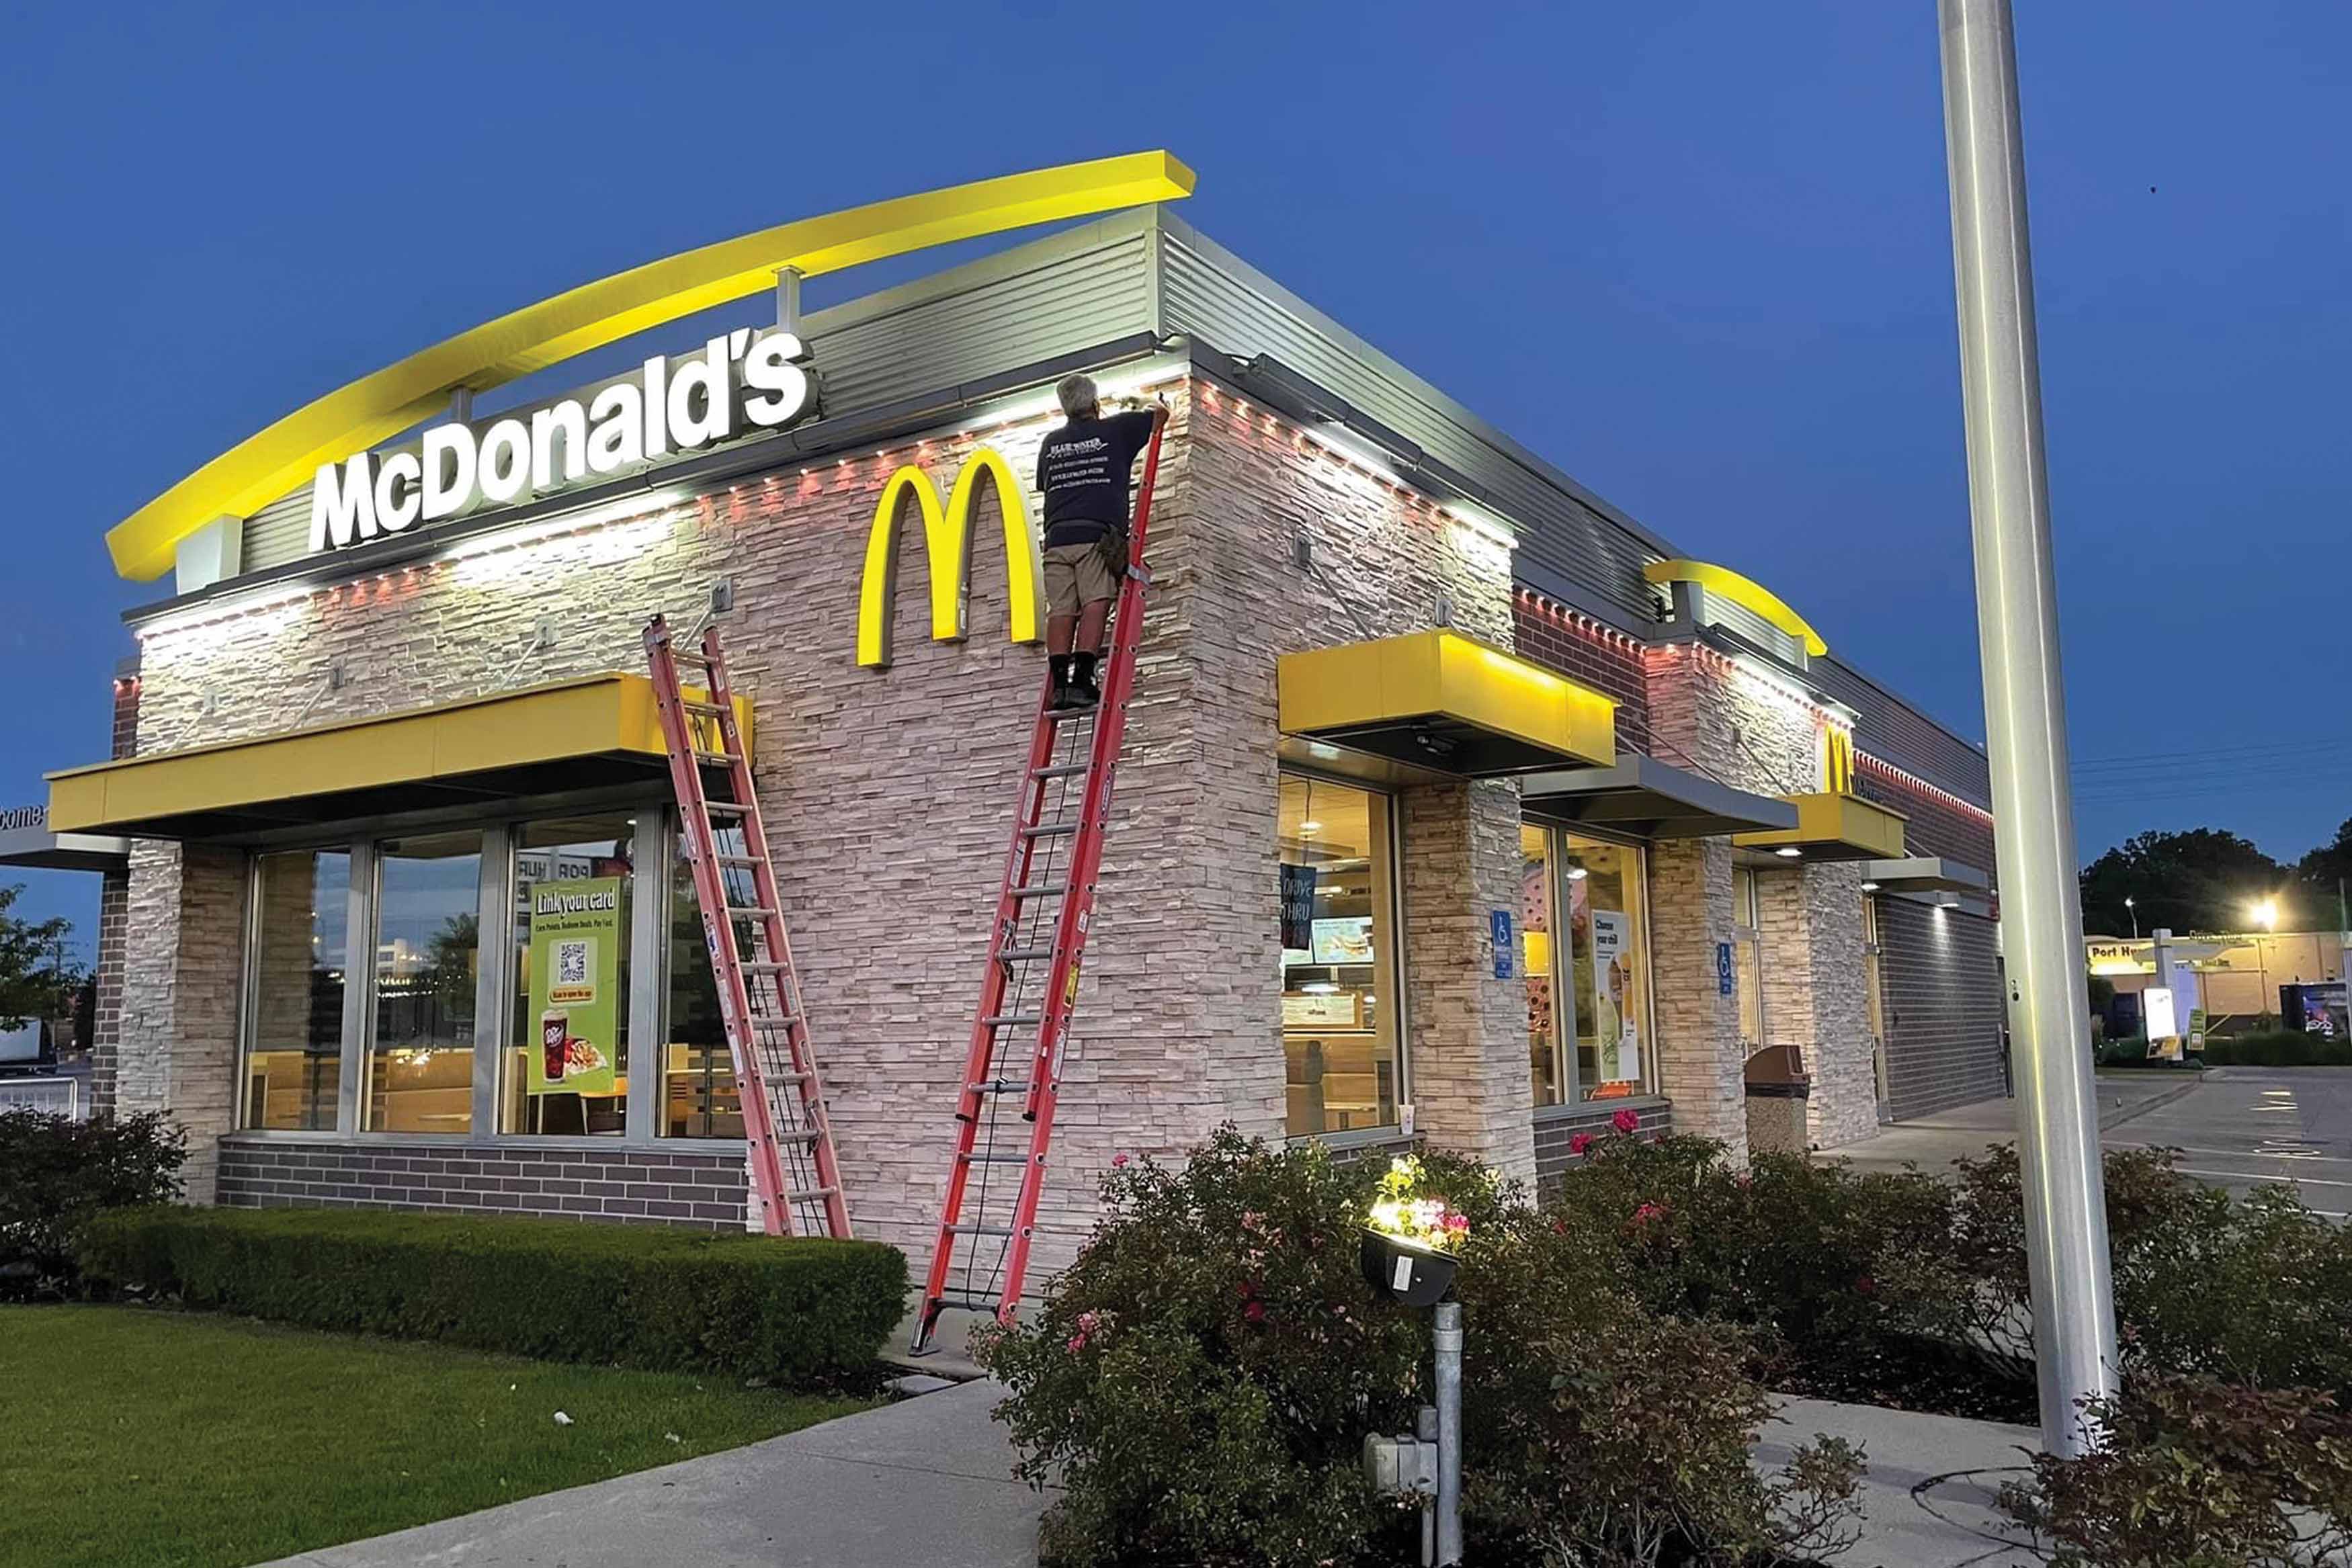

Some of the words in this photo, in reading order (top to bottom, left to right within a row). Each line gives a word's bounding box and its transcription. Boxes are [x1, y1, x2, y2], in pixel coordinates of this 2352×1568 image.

[308, 327, 814, 553] McDonald's
[536, 891, 560, 915] Link
[560, 893, 588, 919] your
[589, 887, 615, 910] card
[2093, 947, 2117, 958] Port
